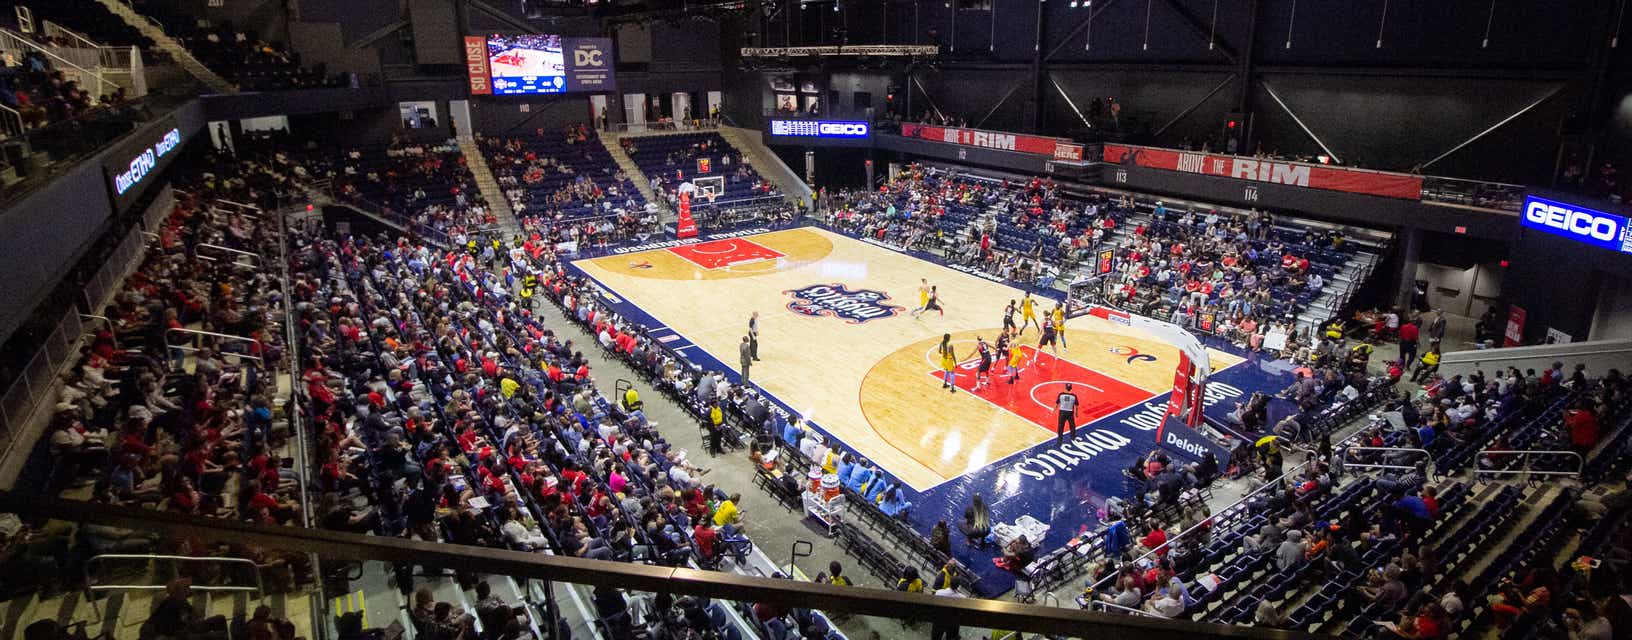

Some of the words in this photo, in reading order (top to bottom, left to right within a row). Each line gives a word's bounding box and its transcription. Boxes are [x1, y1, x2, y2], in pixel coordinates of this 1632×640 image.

[466, 41, 485, 73] CLOSE
[574, 49, 603, 67] DC
[470, 77, 486, 90] SO
[819, 123, 867, 135] GEICO
[973, 131, 1016, 151] RIM
[1116, 171, 1127, 183] 113
[1176, 152, 1206, 175] ABOVE
[1213, 159, 1225, 175] THE
[1231, 158, 1311, 188] RIM
[1244, 188, 1258, 201] 114
[1526, 202, 1617, 241] GEICO
